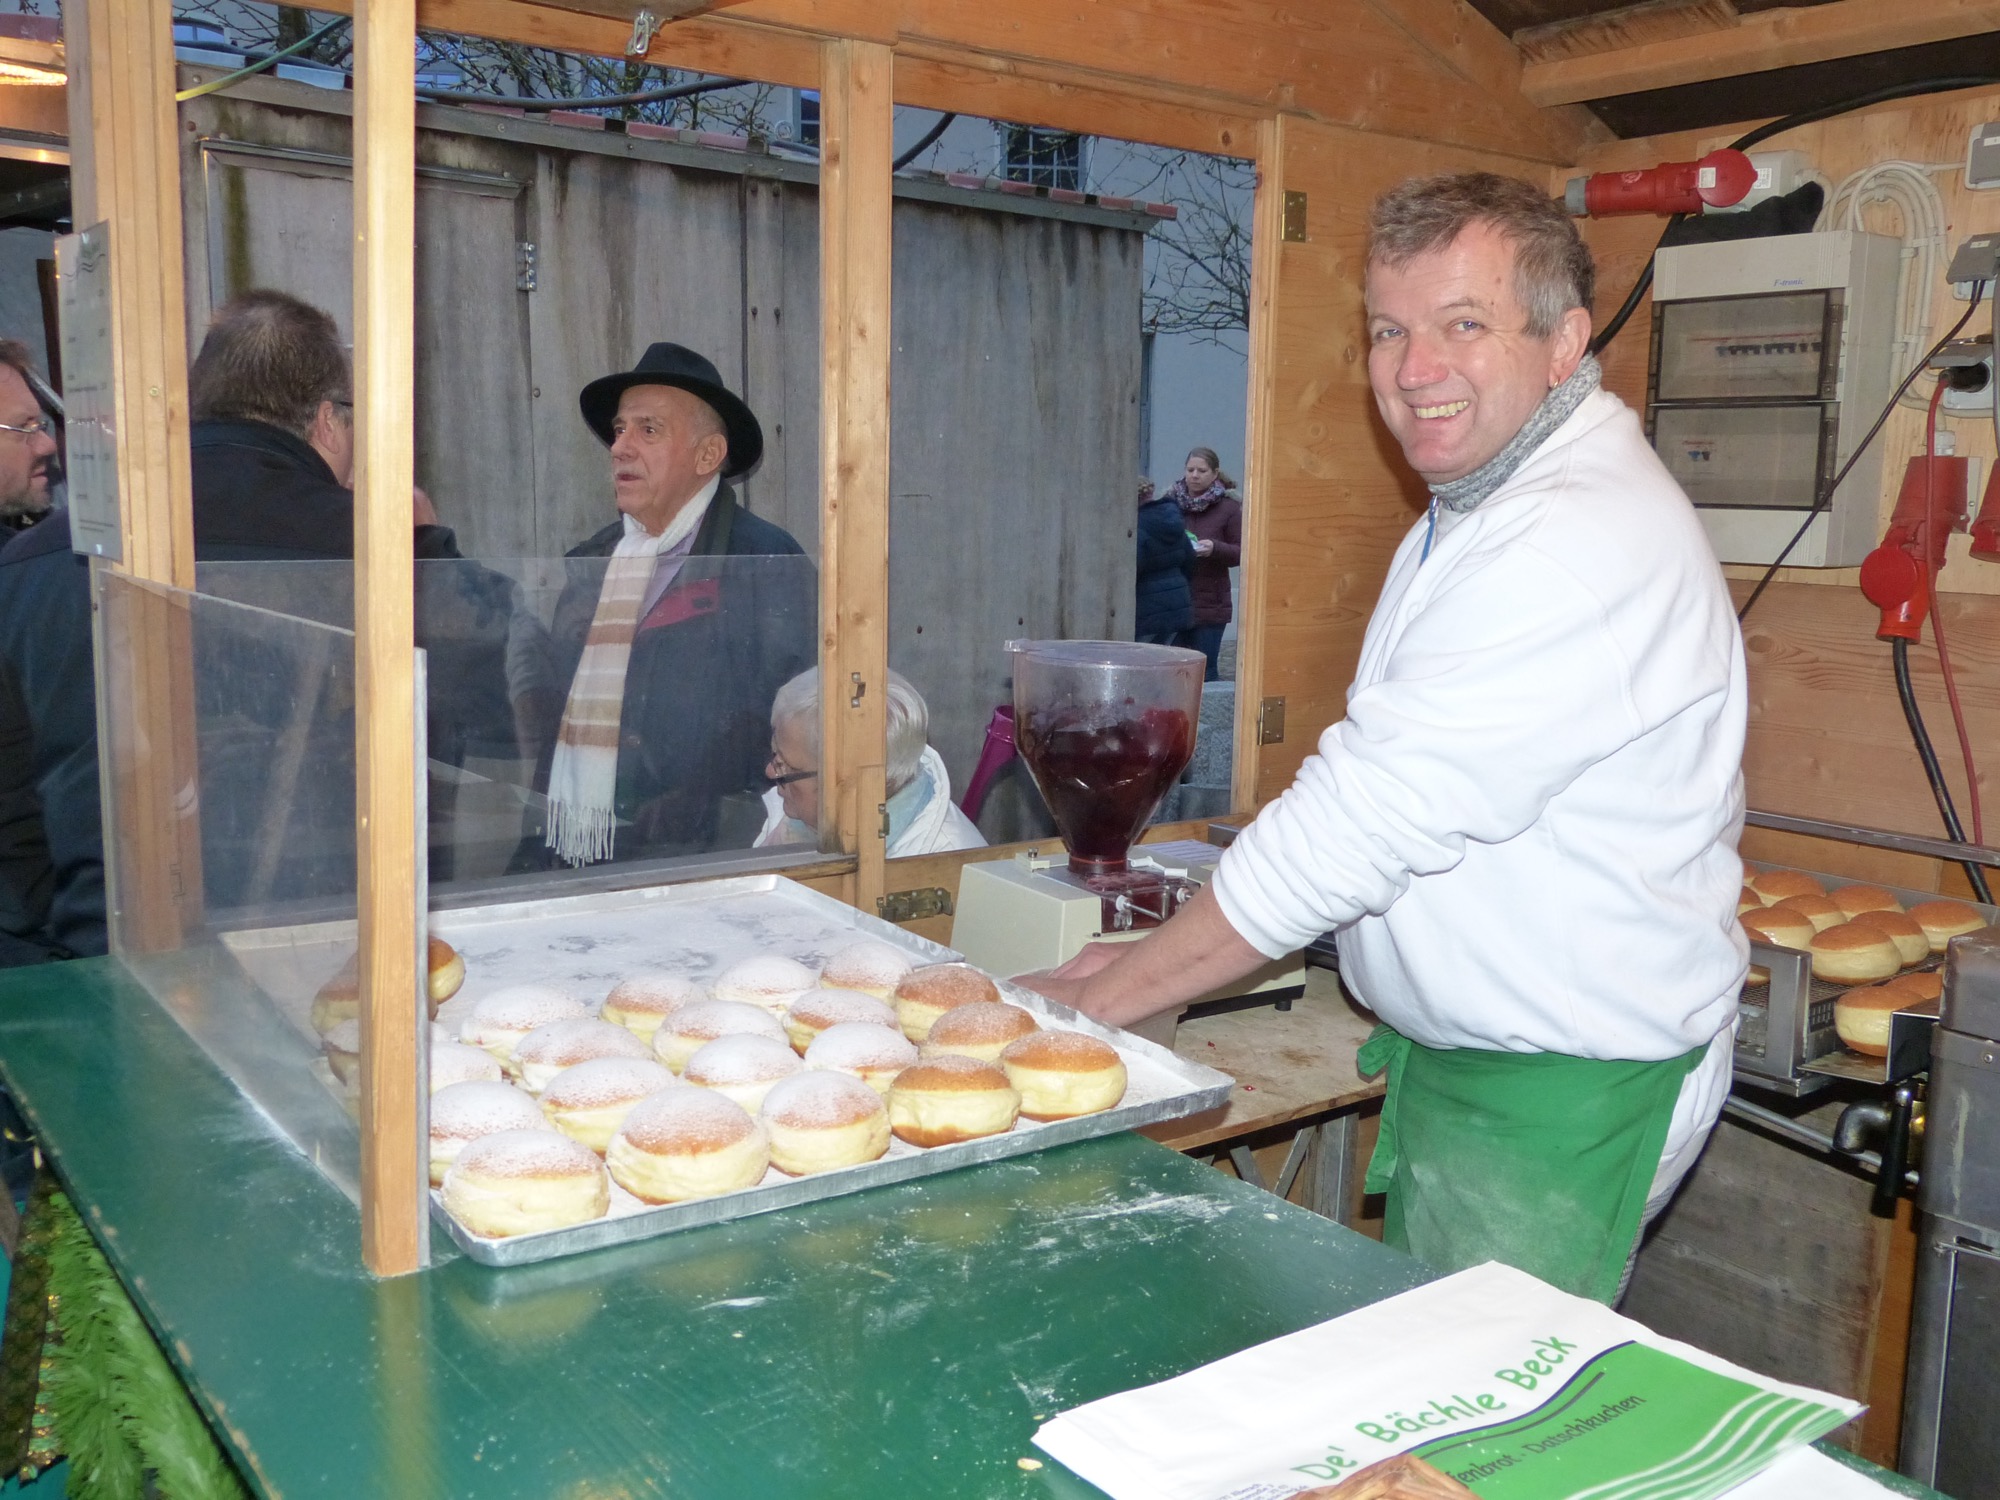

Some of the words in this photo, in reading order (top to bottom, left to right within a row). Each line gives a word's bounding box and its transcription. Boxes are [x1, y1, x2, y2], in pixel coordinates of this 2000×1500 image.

[1355, 1393, 1507, 1443] Bächle
[1494, 1336, 1578, 1391] Beck
[1521, 1395, 1647, 1454] Datschkuchen
